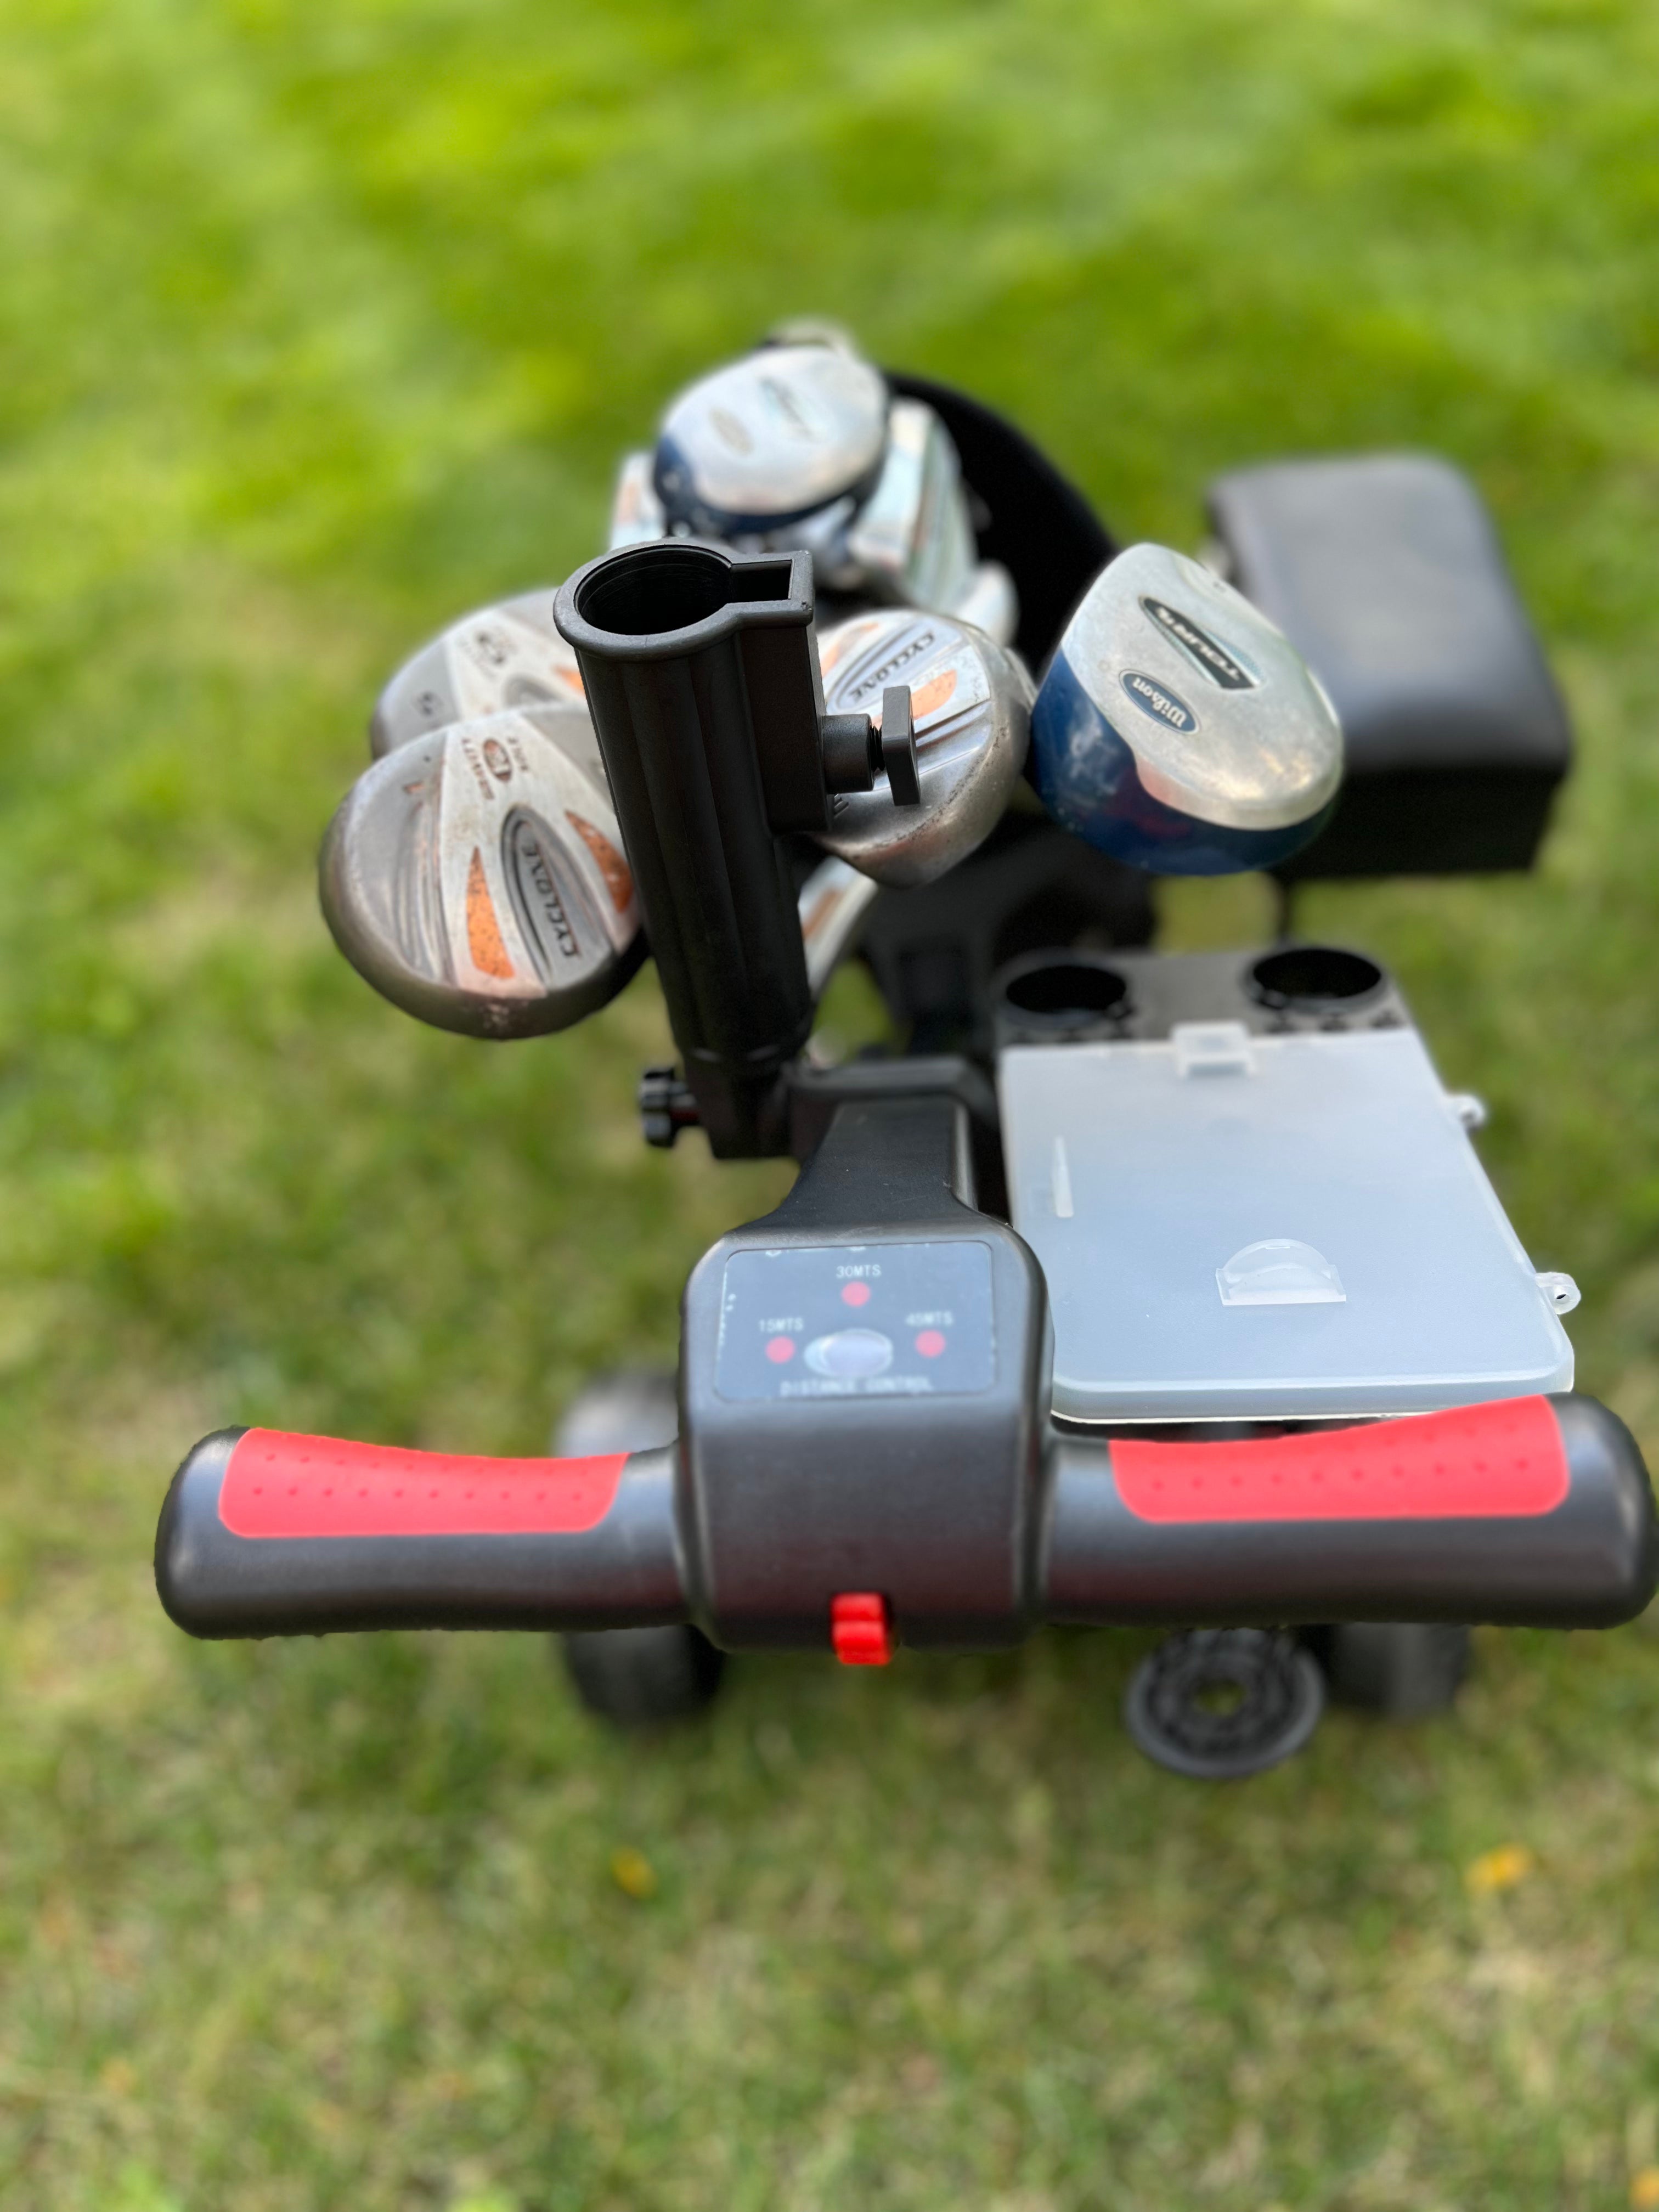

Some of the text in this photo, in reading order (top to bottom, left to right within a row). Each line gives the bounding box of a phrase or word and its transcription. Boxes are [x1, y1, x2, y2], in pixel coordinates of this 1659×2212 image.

[849, 632, 935, 703] CYCLONE
[1132, 676, 1187, 728] Wilson
[523, 843, 580, 957] CYCLONE
[836, 1264, 882, 1279] 30MTS
[758, 1317, 804, 1333] 15MTS
